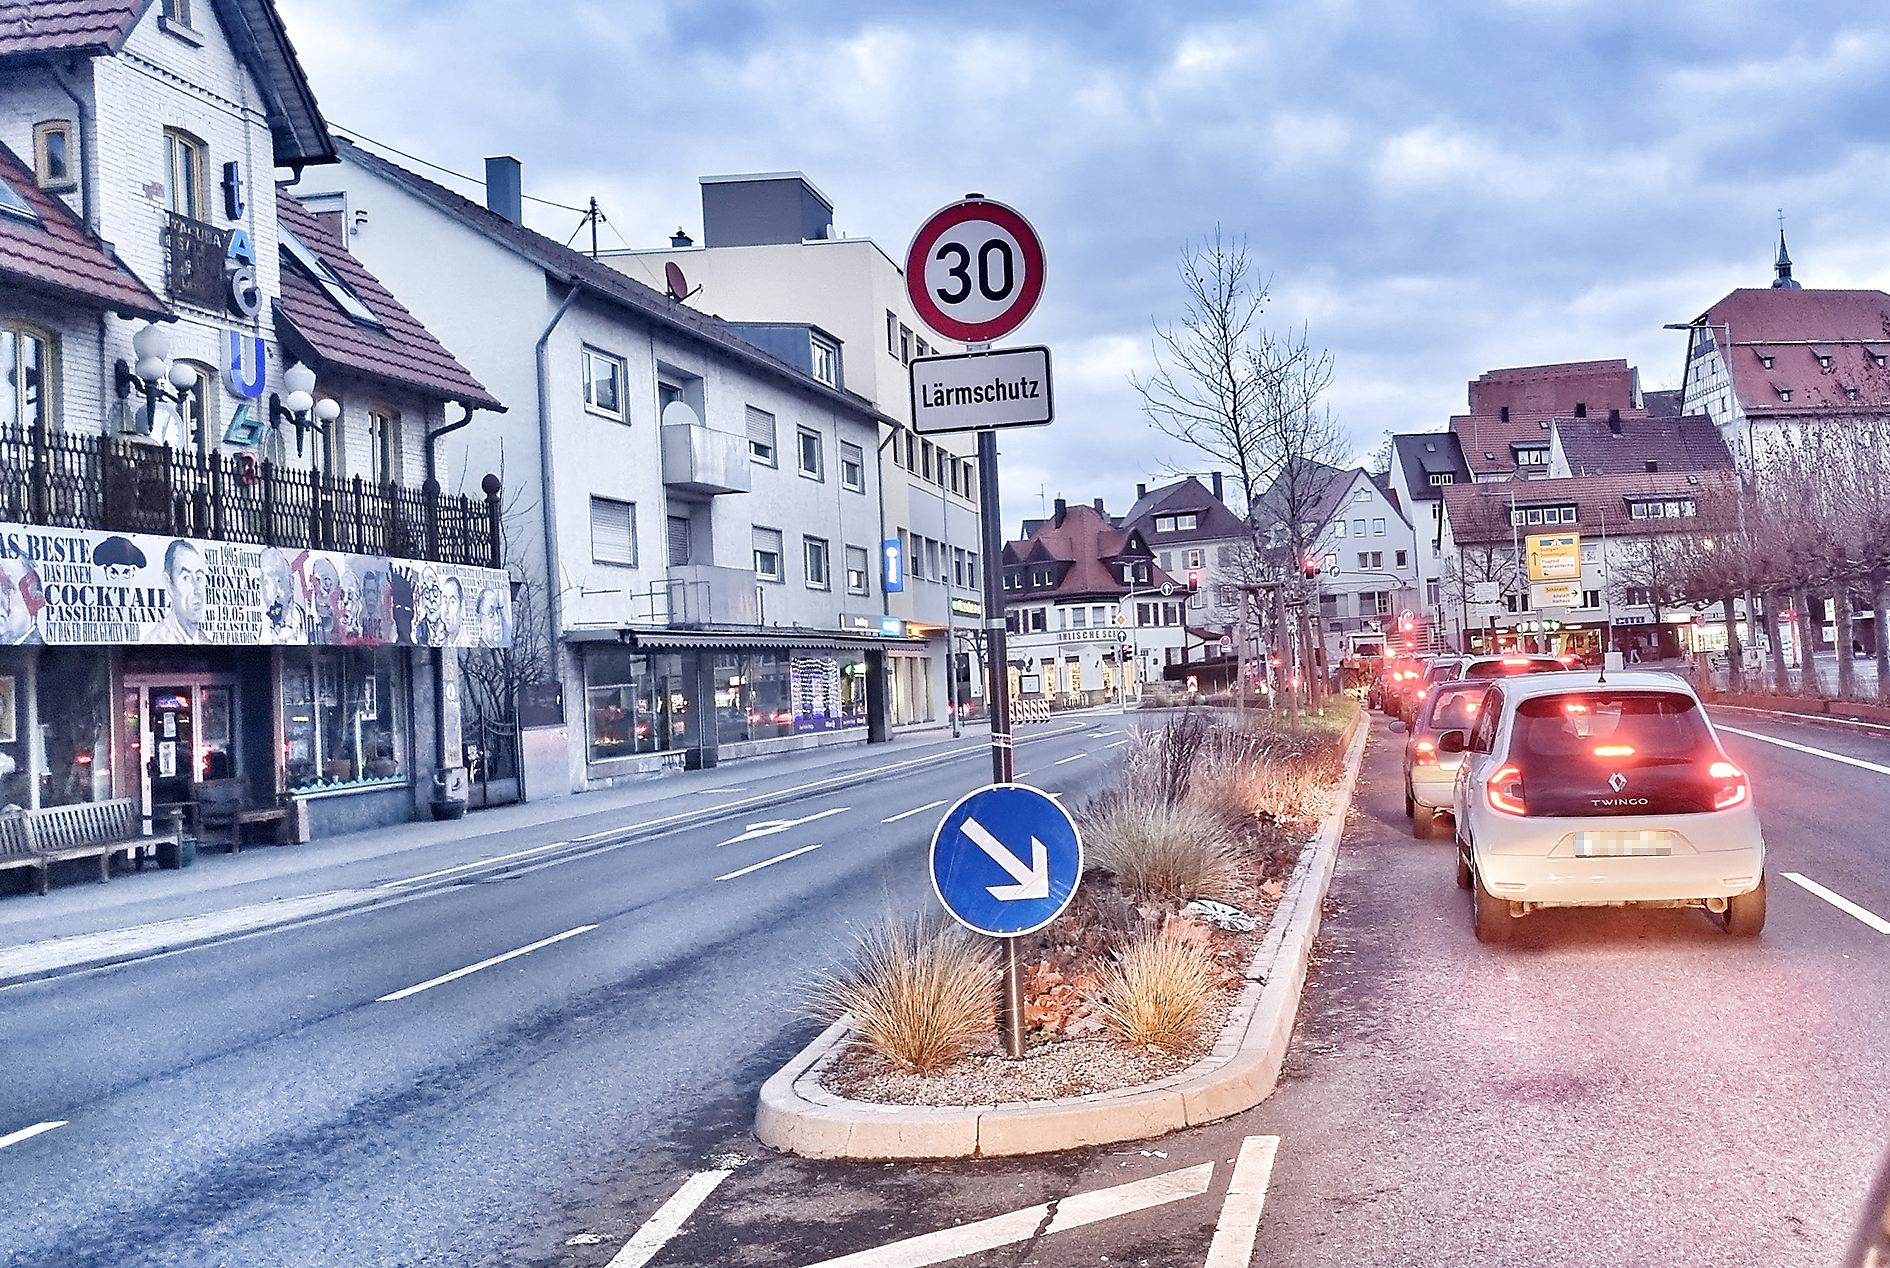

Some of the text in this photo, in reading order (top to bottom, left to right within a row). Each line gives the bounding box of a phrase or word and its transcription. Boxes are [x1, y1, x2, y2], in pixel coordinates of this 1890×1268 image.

[936, 238, 1014, 304] 30
[922, 376, 1040, 408] Lärmschutz
[26, 535, 91, 563] BESTE
[220, 546, 238, 566] 1995
[43, 564, 92, 584] DAS EINEM
[231, 567, 249, 577] VON
[205, 574, 260, 590] MONTAG
[44, 584, 172, 608] COCKTAIL
[205, 588, 260, 607] BIS SAMSTAG
[46, 606, 167, 623] PASSIEREN KANN
[205, 610, 215, 621] AB
[218, 606, 244, 621] 19.05
[198, 622, 214, 631] DIE
[1591, 798, 1648, 806] TWINGO
